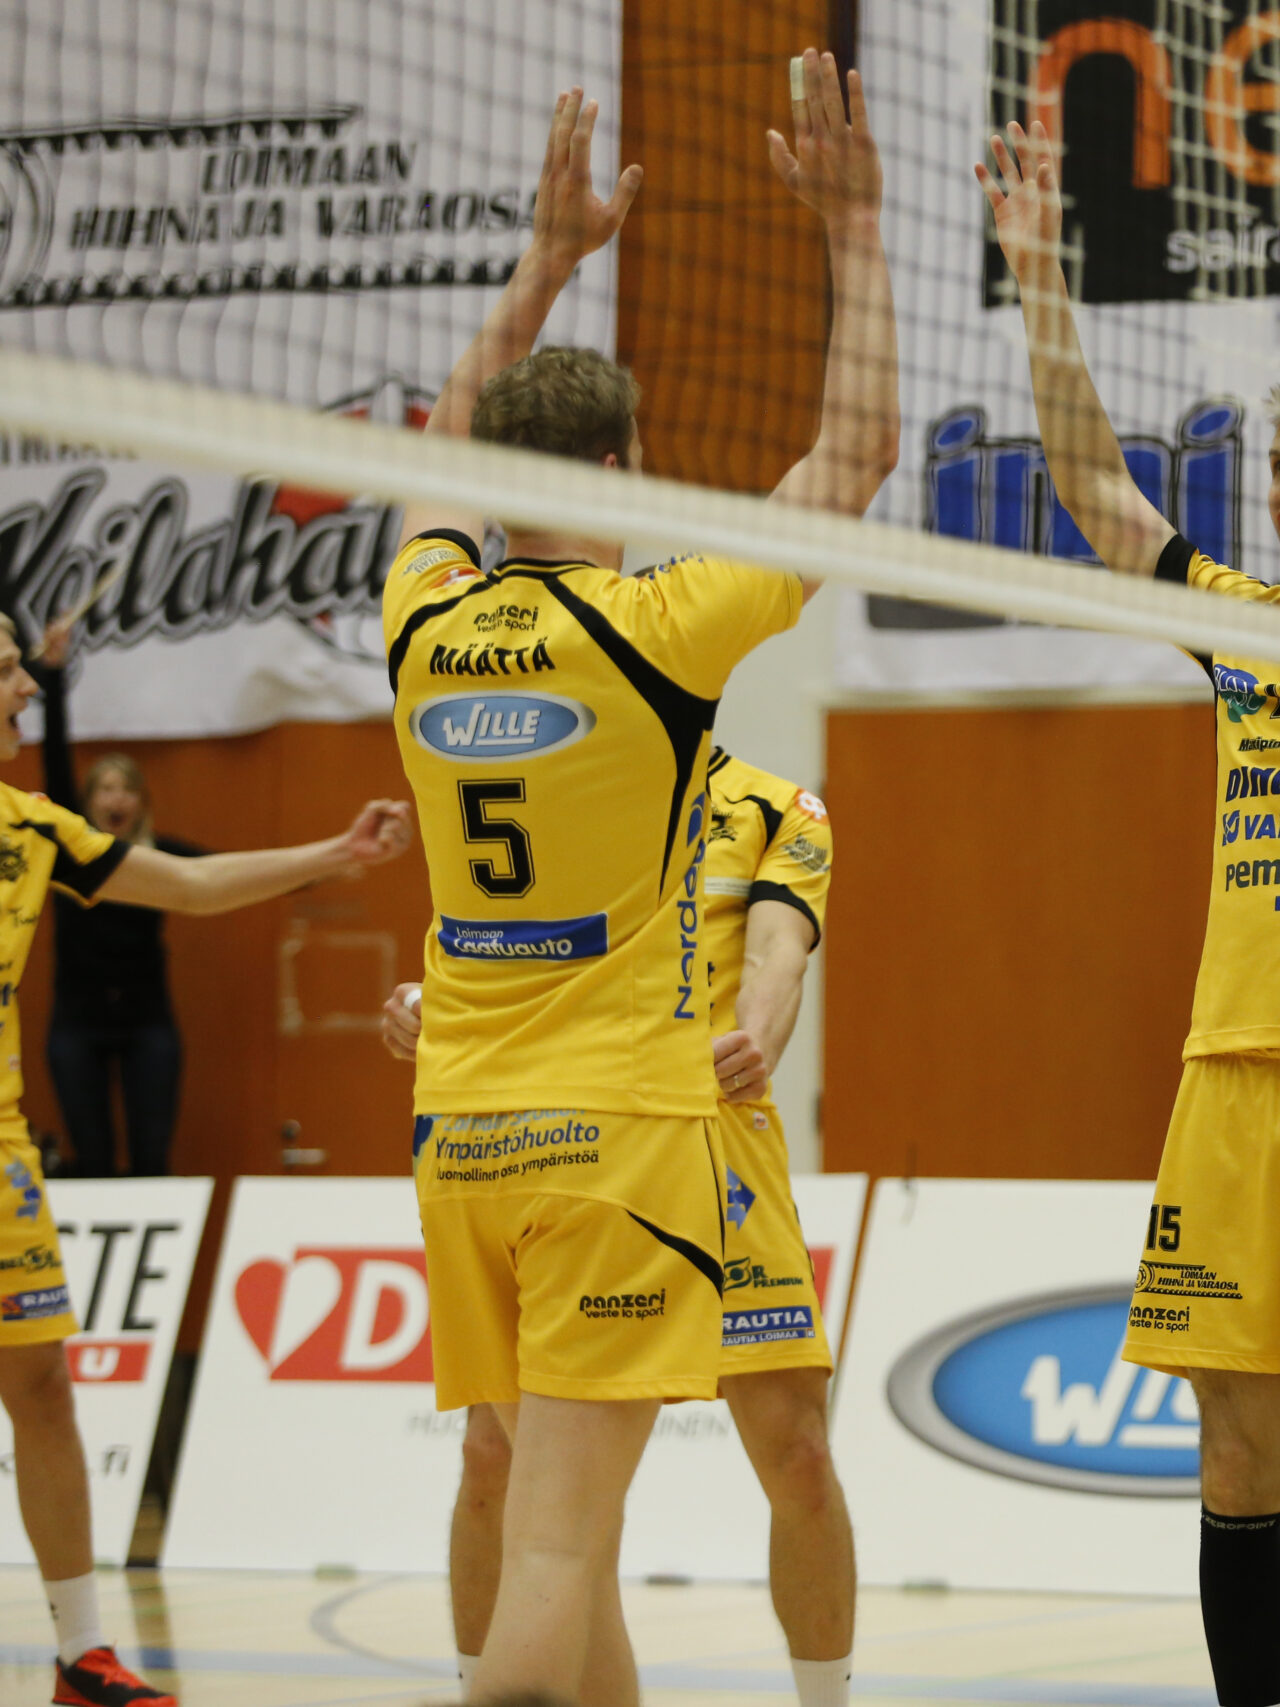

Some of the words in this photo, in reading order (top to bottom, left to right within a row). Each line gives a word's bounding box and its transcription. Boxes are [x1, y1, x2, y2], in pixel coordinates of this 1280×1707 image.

[204, 141, 416, 194] LOIMAAN
[229, 199, 286, 240] JA
[430, 637, 556, 677] MÄÄTTÄ
[442, 702, 541, 746] WILLE
[456, 777, 536, 899] 5
[673, 841, 706, 1019] Nordea
[436, 1119, 600, 1167] Ympäristöhuolto
[500, 1163, 519, 1179] osa
[521, 1149, 600, 1176] ympäristöä
[1145, 1203, 1182, 1252] 15
[579, 1288, 667, 1311] panzeri
[1157, 1277, 1184, 1287] HIHNA
[1197, 1280, 1239, 1291] VARAOSA
[585, 1309, 618, 1319] veste
[635, 1305, 666, 1321] sport
[722, 1310, 808, 1331] RAUTIA
[1166, 1321, 1190, 1334] sport
[759, 1331, 799, 1342] LOIMAA
